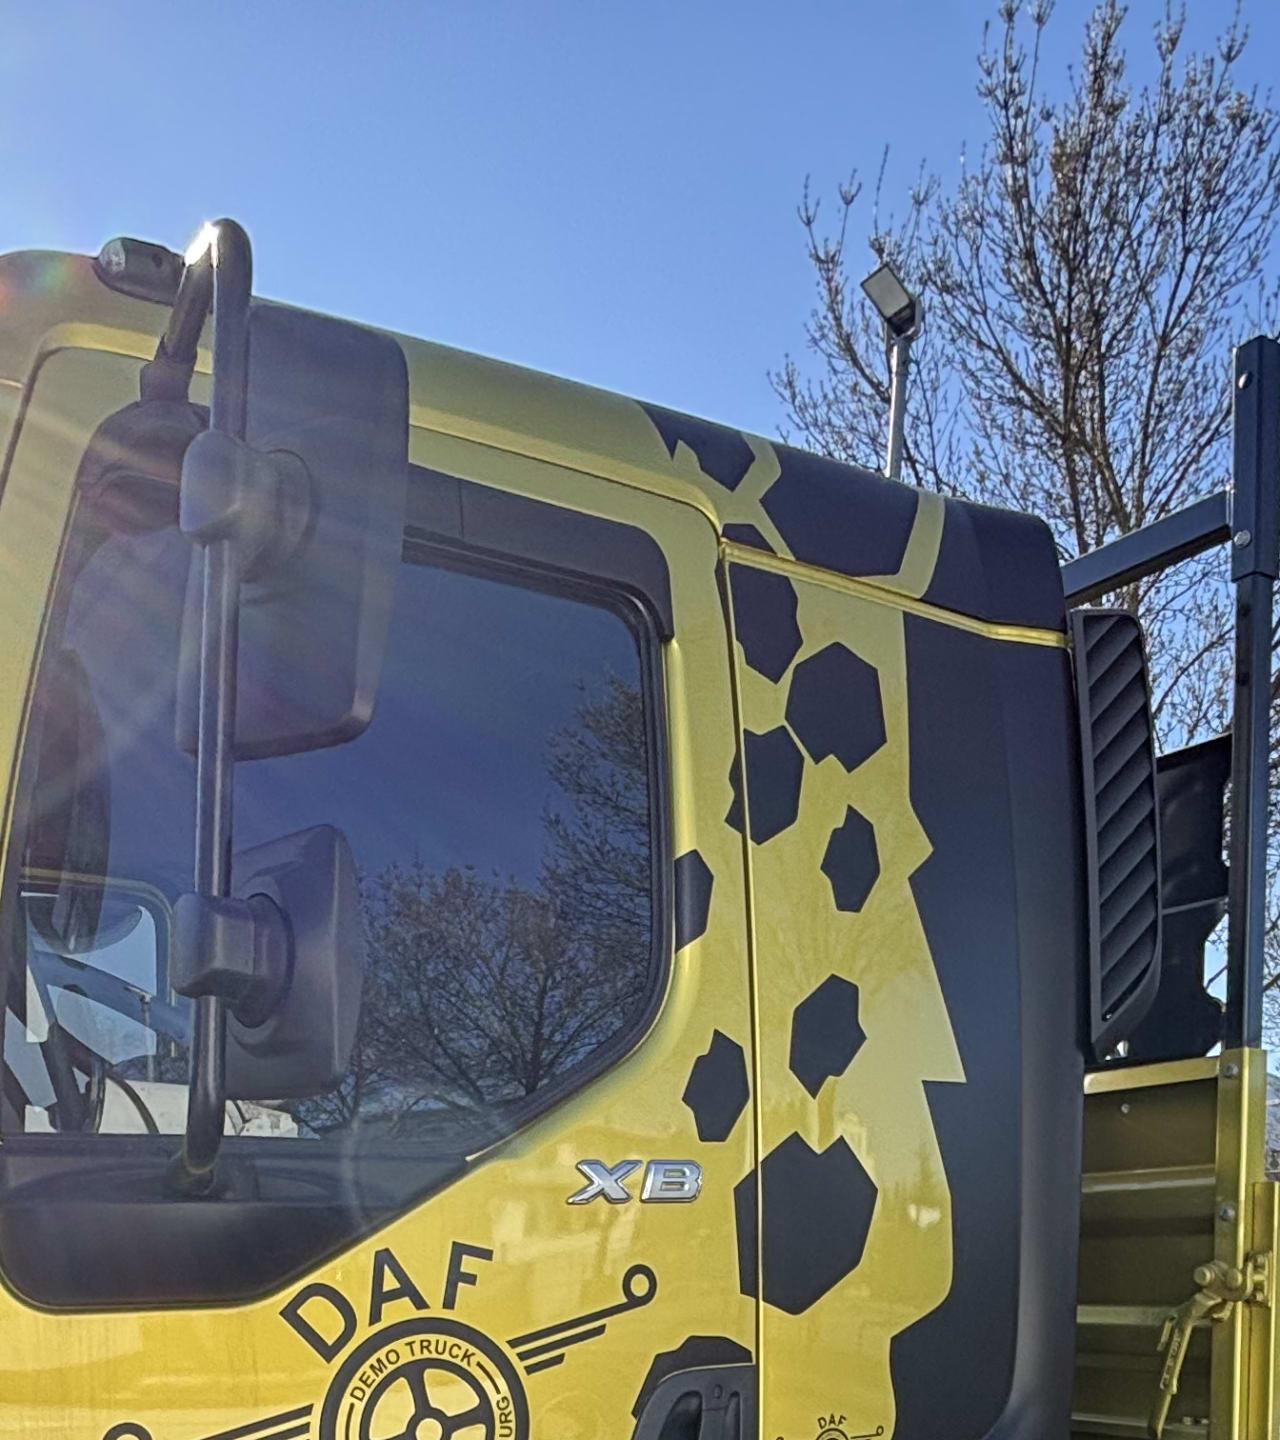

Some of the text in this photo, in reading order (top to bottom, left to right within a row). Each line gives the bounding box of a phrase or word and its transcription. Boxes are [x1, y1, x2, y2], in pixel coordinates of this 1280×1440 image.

[567, 1159, 703, 1204] XB
[279, 1241, 494, 1364] DAF
[350, 1339, 477, 1403] DEMO TRUCK
[817, 1413, 847, 1430] DAF
